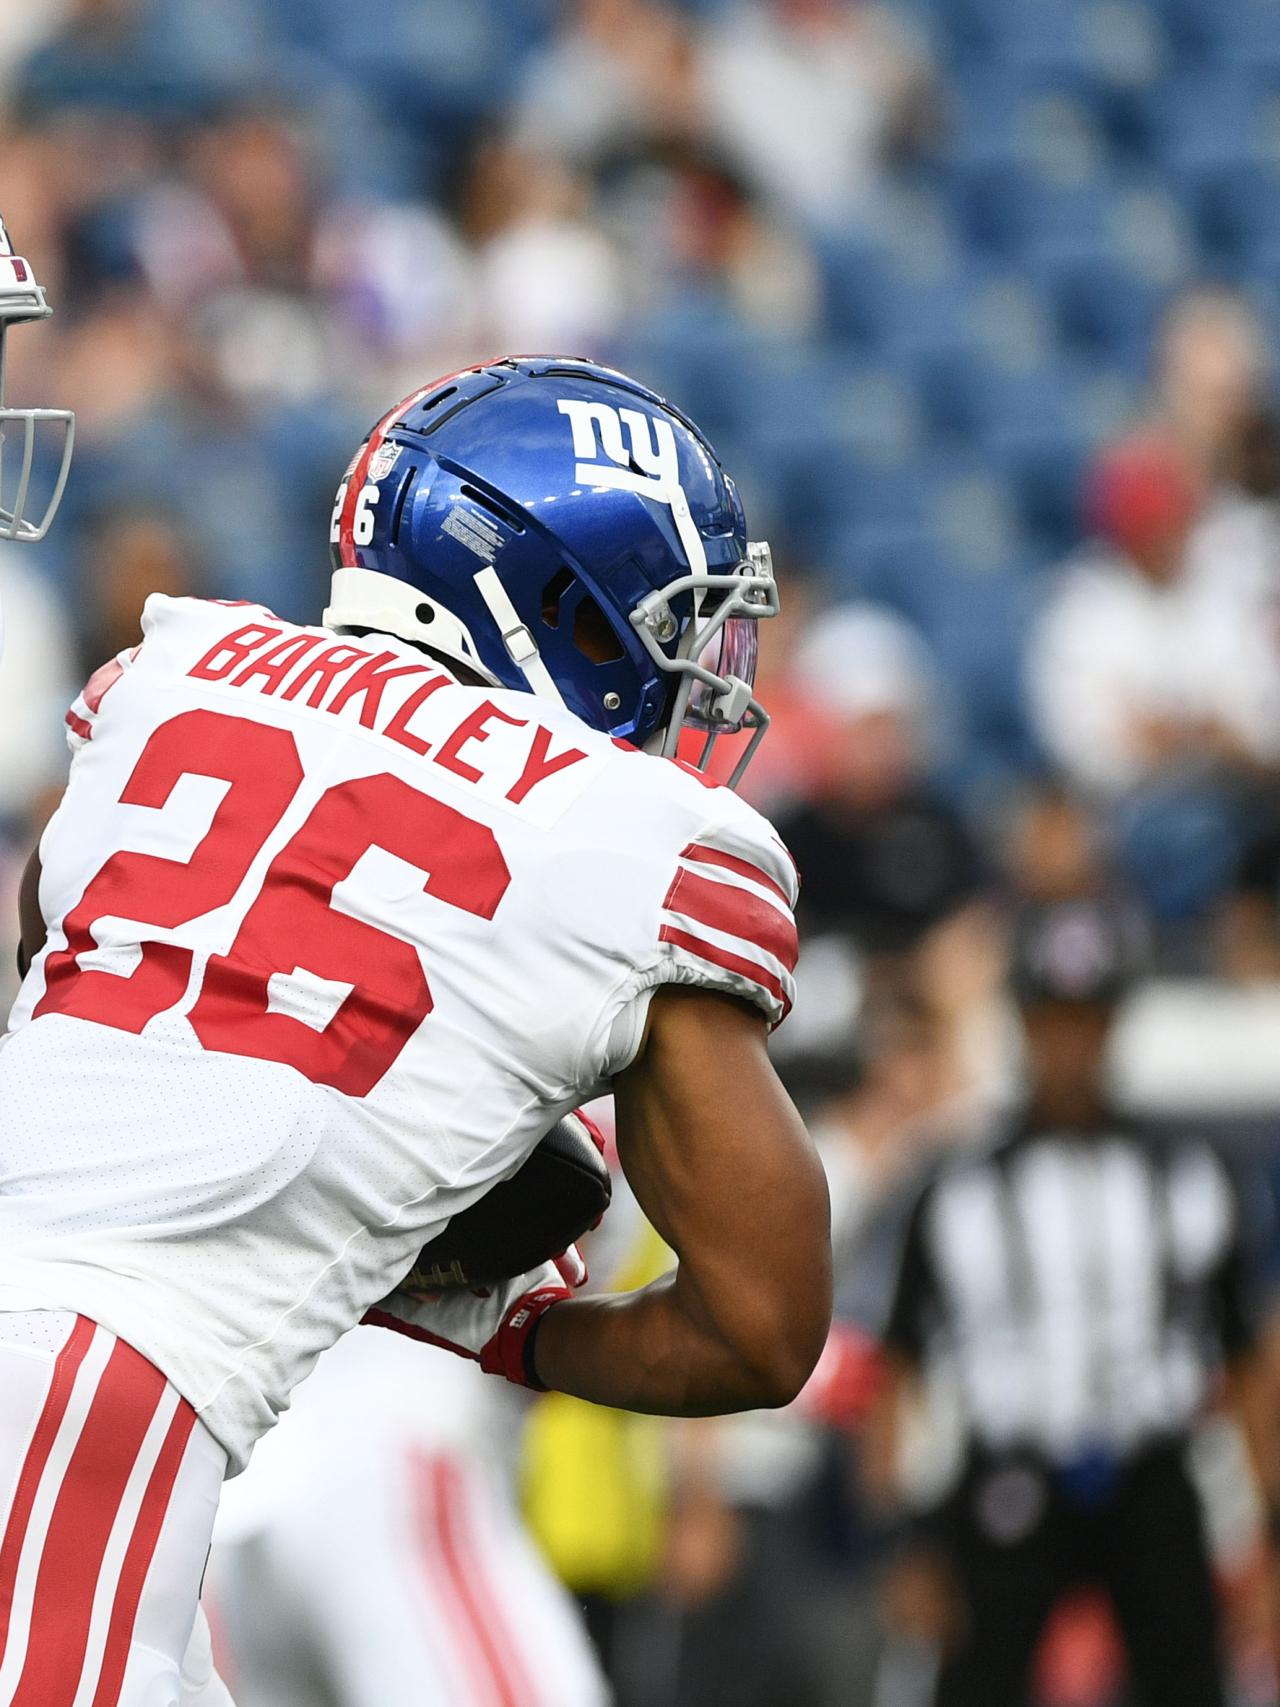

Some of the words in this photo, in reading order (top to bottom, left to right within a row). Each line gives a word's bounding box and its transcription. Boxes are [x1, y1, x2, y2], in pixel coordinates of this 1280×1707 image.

[330, 484, 380, 546] 26
[186, 622, 589, 805] BARKLEY
[31, 708, 512, 1098] 26
